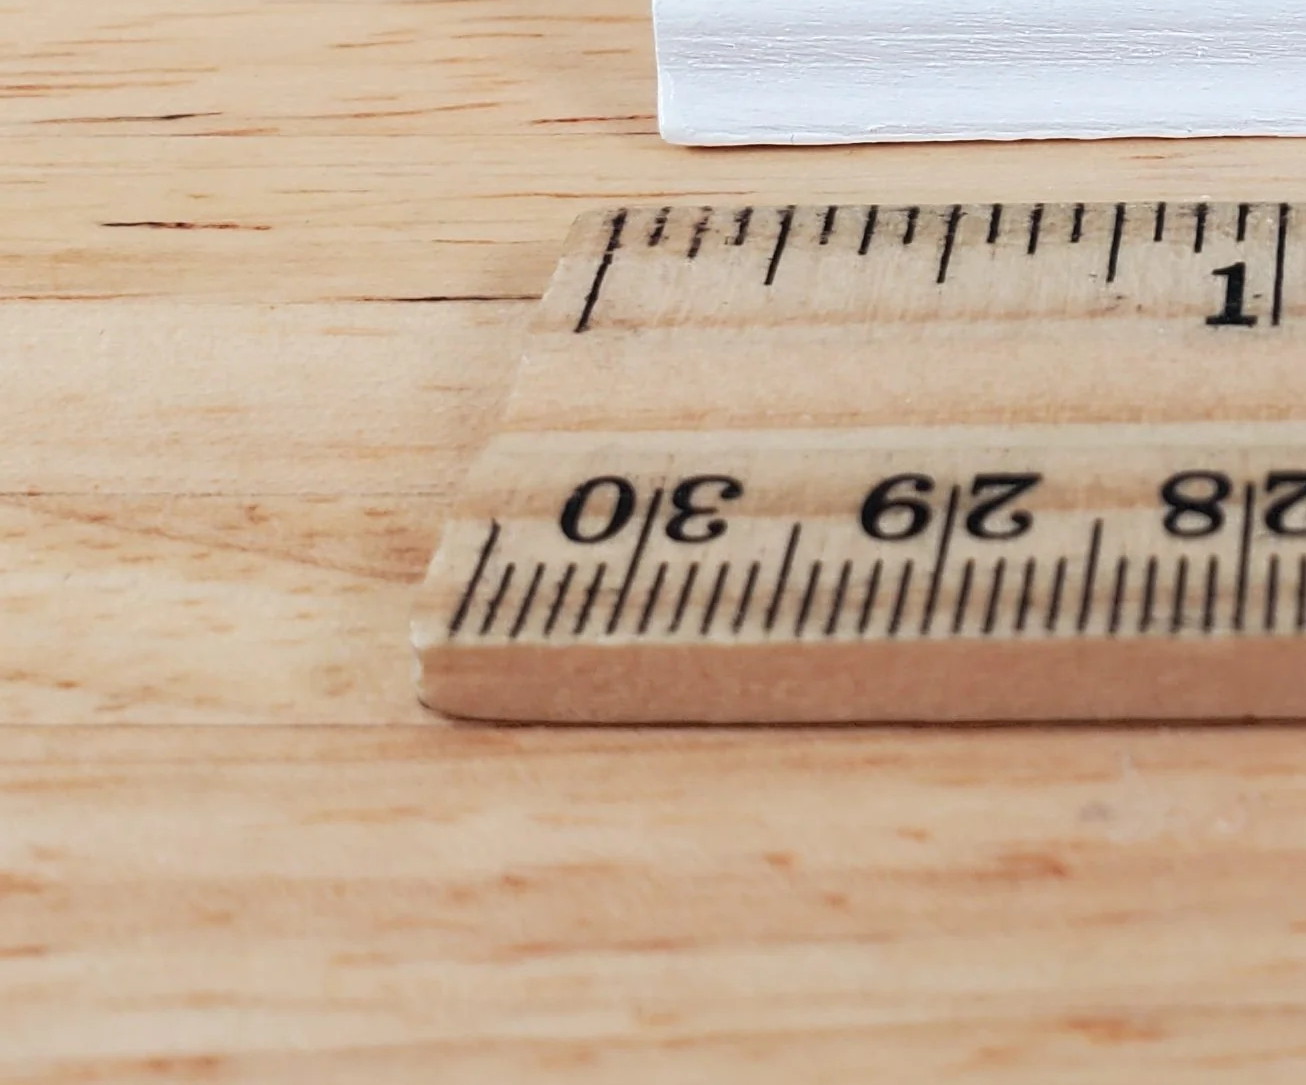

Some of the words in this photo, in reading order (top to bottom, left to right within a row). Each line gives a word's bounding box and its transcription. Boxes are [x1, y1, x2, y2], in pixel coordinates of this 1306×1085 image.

[1205, 262, 1257, 326] 1
[559, 475, 744, 545] 30
[860, 472, 1043, 543] 29
